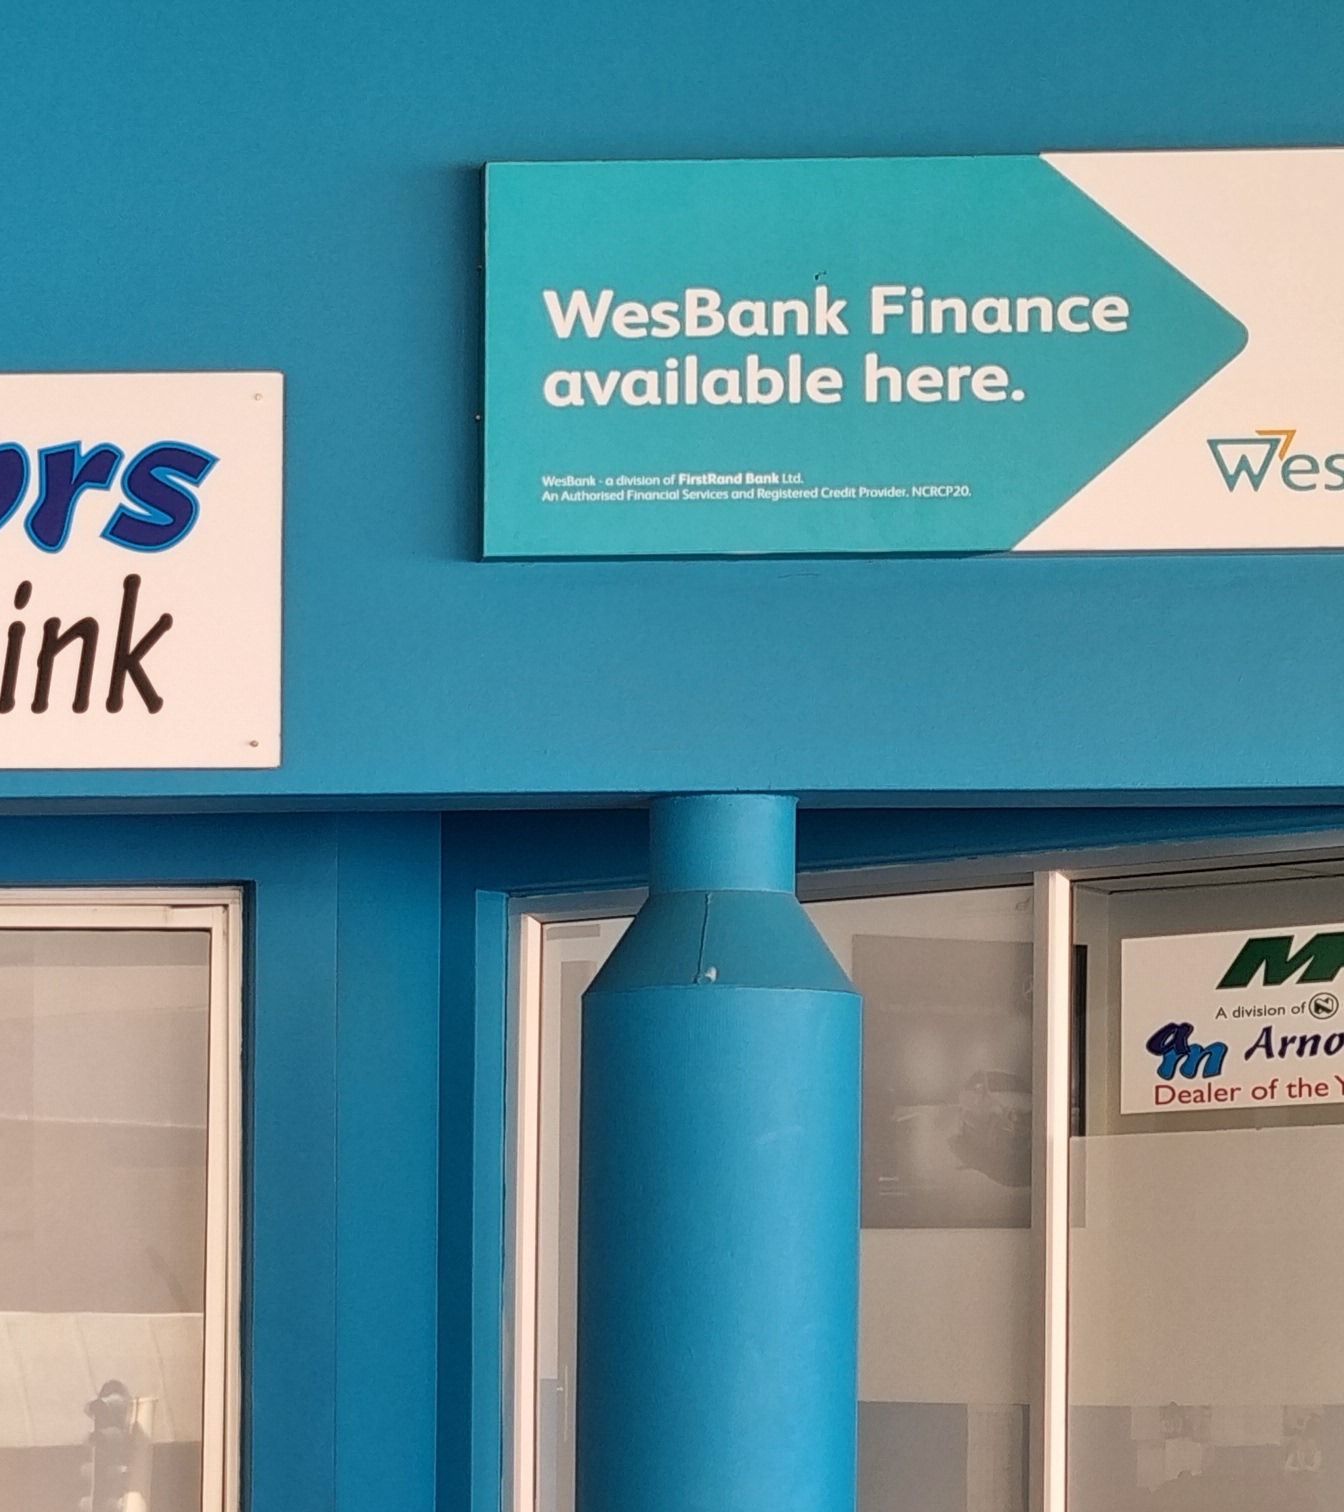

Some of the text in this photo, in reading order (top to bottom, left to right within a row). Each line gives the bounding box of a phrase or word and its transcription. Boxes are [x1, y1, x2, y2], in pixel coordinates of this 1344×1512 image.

[542, 284, 1131, 340] WesBank Finance
[542, 352, 1027, 407] available here.
[1206, 430, 1344, 493] Wes
[541, 490, 559, 502] An
[561, 489, 625, 502] Authorised
[627, 489, 680, 501] Financial
[682, 488, 729, 500] Services
[731, 487, 754, 499] and
[757, 487, 819, 502] Registered
[820, 486, 857, 499] Credit
[542, 475, 596, 487] WesBank
[605, 478, 614, 487] a
[616, 475, 660, 487] division
[663, 474, 677, 486] of
[678, 473, 743, 486] FirstRand
[745, 473, 779, 485] Bank
[782, 473, 804, 485] Ltd.
[1215, 1001, 1306, 1020] A division of
[1155, 1082, 1242, 1106] Dealer
[1251, 1078, 1279, 1101] of
[1286, 1077, 1330, 1099] the
